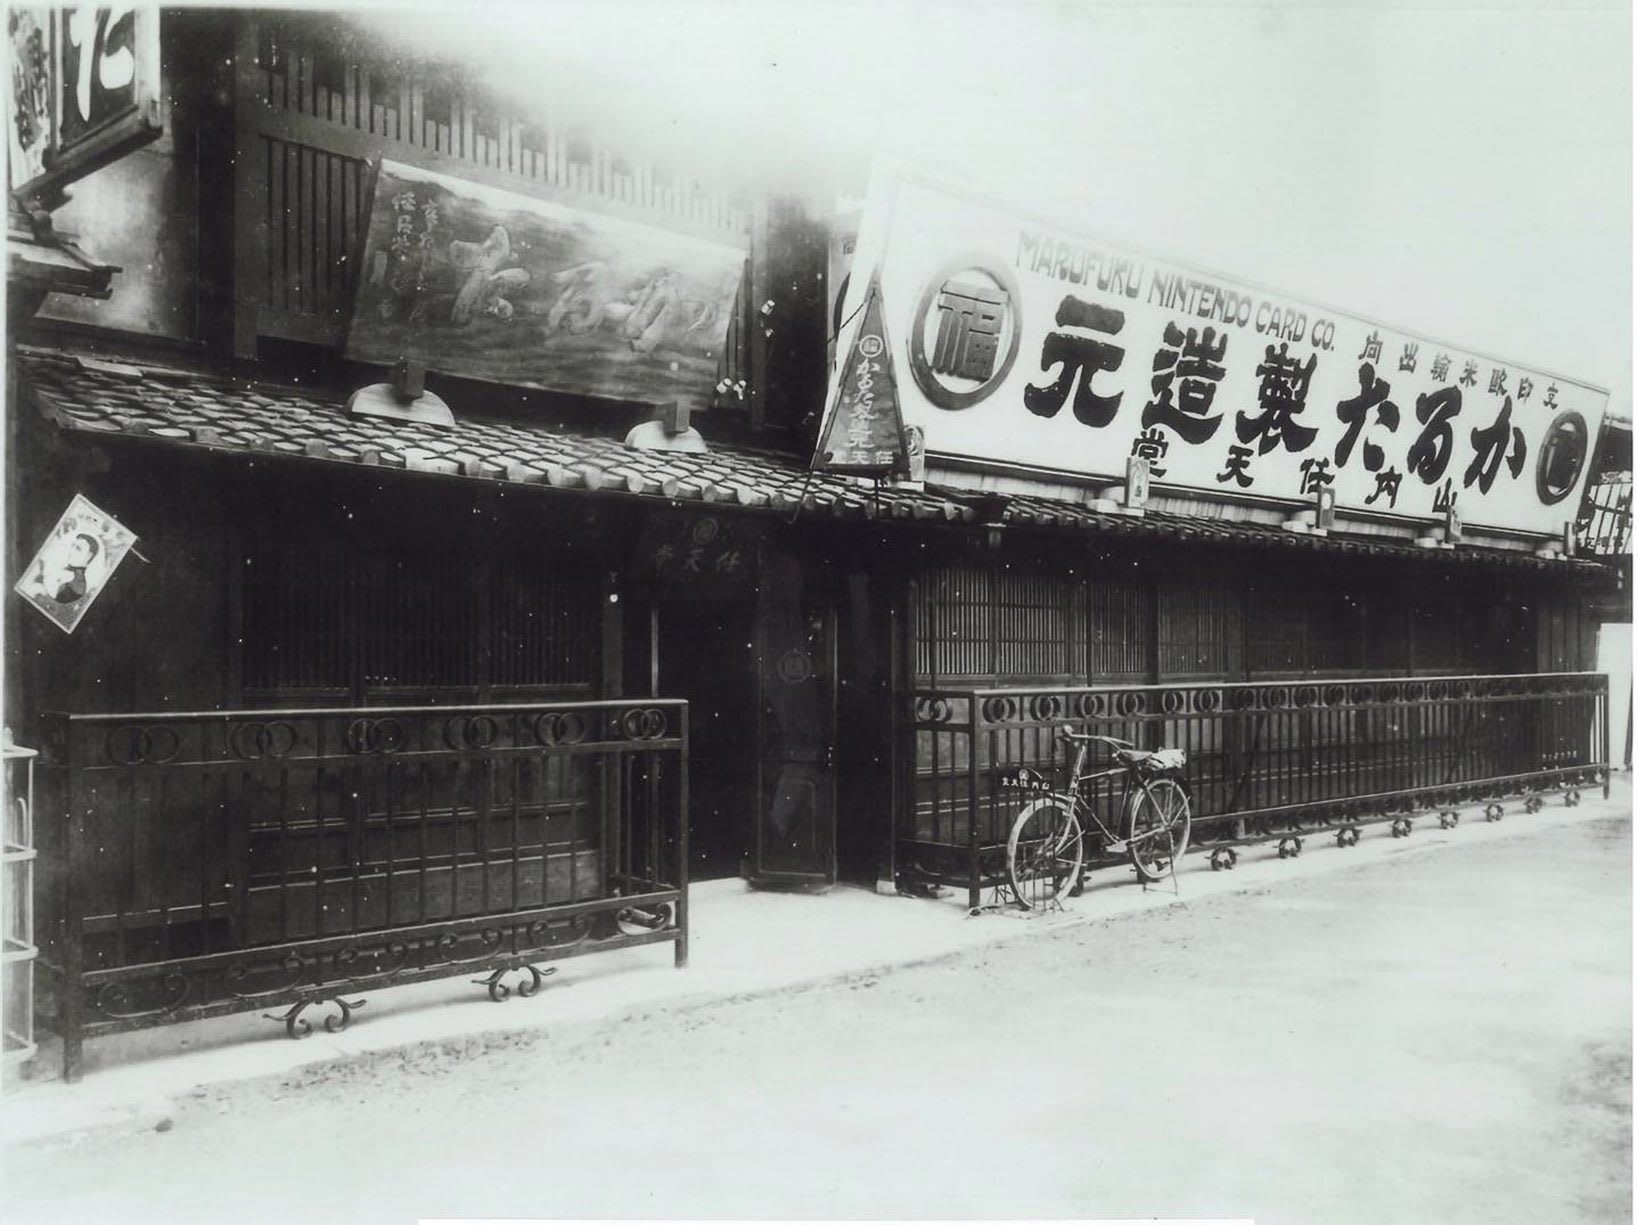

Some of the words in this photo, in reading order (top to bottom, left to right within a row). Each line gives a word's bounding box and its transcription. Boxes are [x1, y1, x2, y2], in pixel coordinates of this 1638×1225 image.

[1016, 230, 1144, 299] MARUFUKU
[1147, 266, 1250, 328] NINTENDO
[1255, 301, 1307, 343] CARD
[1311, 318, 1335, 352] CO.
